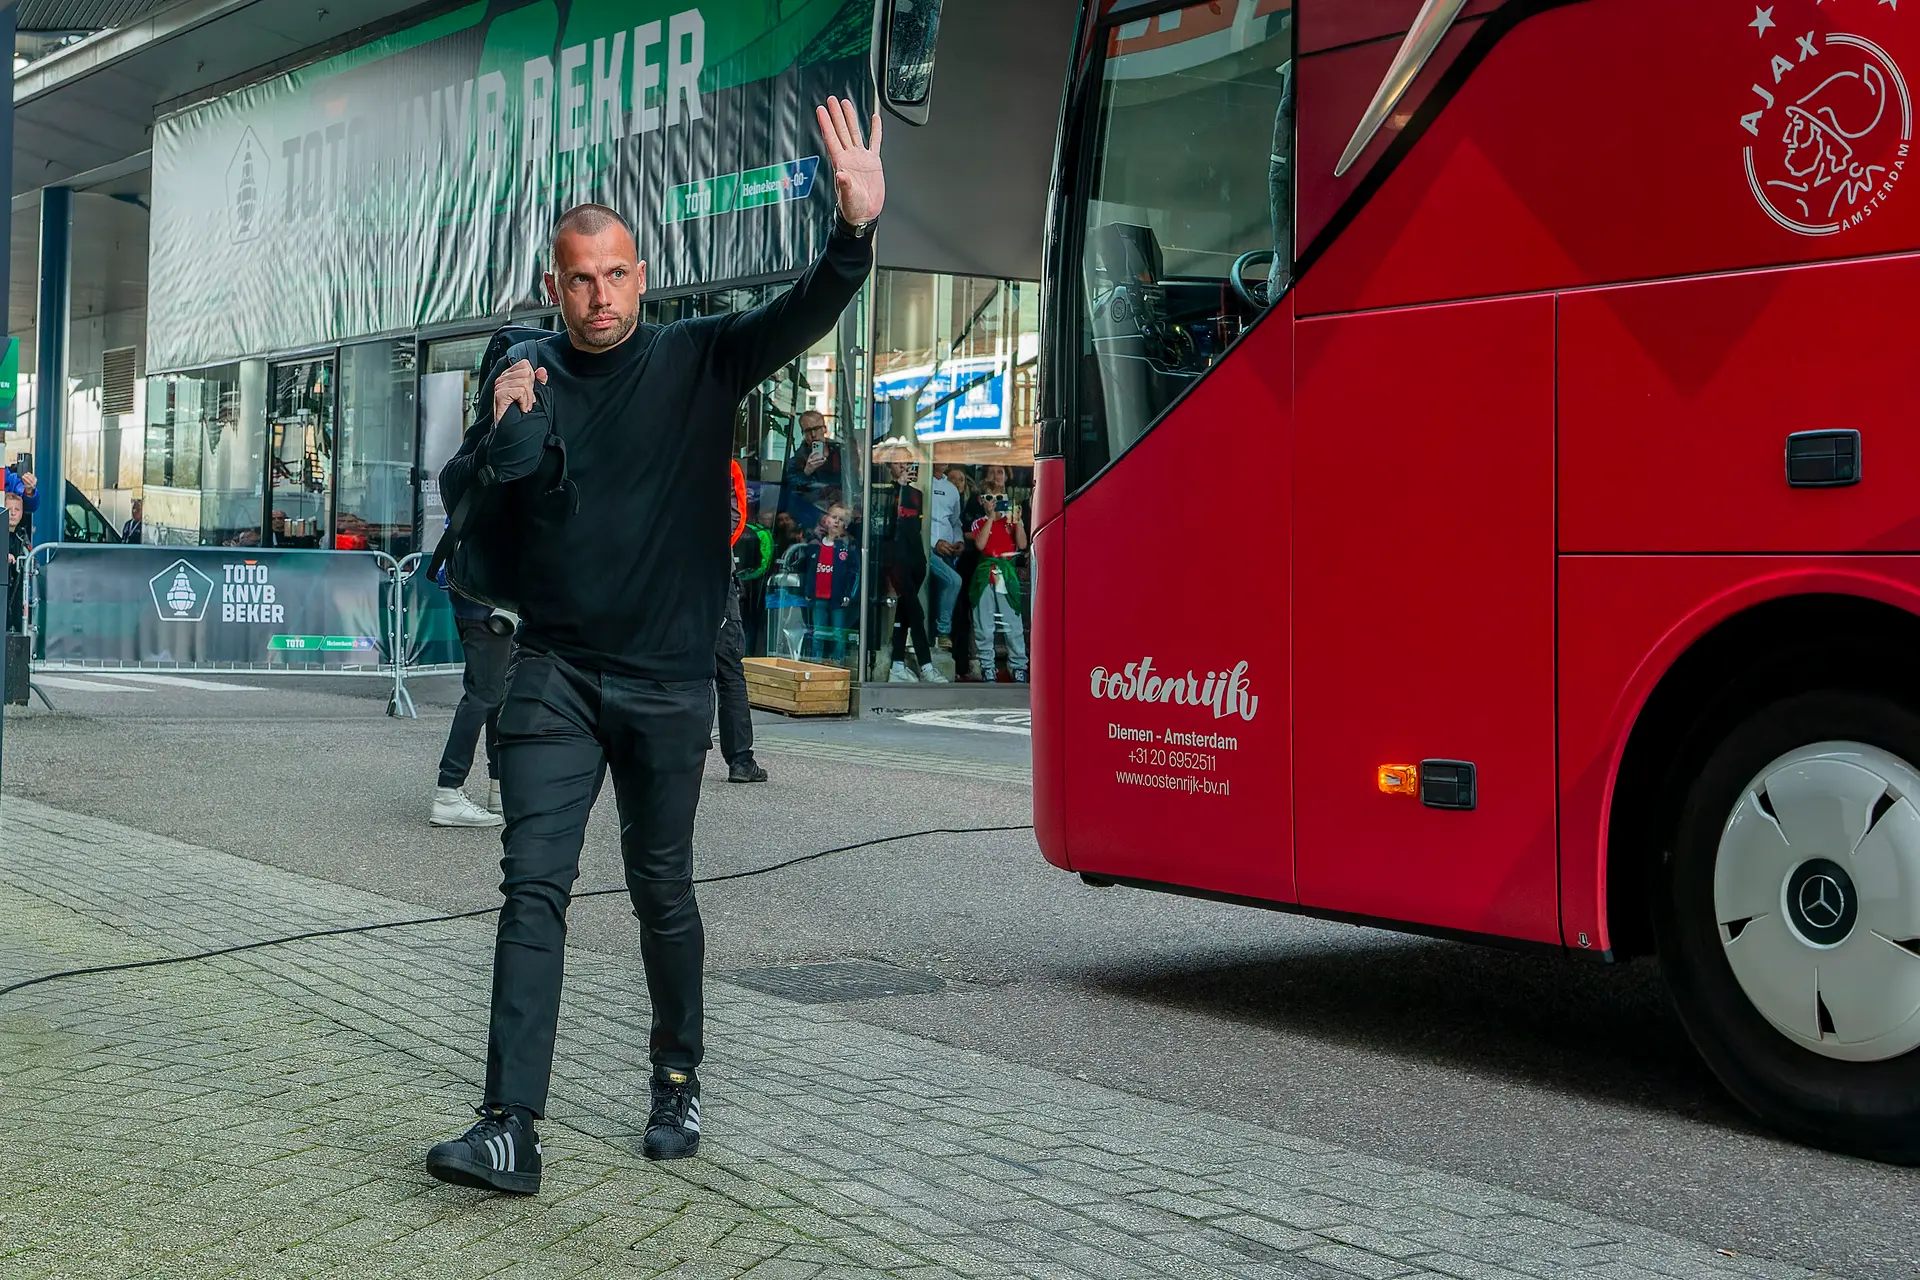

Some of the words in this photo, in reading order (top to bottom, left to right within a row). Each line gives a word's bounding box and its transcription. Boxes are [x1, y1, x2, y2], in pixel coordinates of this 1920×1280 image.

[523, 8, 706, 162] BEKER
[1740, 30, 1819, 136] AJAX
[685, 190, 711, 214] TOTO
[743, 179, 781, 197] Heineken
[1842, 143, 1910, 230] AMSTERDAM
[222, 564, 268, 584] TOTO
[222, 584, 276, 603] KNVB
[222, 604, 284, 623] BEKER
[286, 639, 305, 648] TOTO
[1090, 656, 1258, 721] oostenrijk
[1108, 723, 1153, 743] Diemen
[1164, 728, 1238, 751] Amsterdam
[1128, 747, 1148, 764] +31
[1150, 749, 1166, 766] 20
[1169, 750, 1216, 772] 6952511
[1116, 771, 1230, 796] www.oostenrijk-bv.nl
